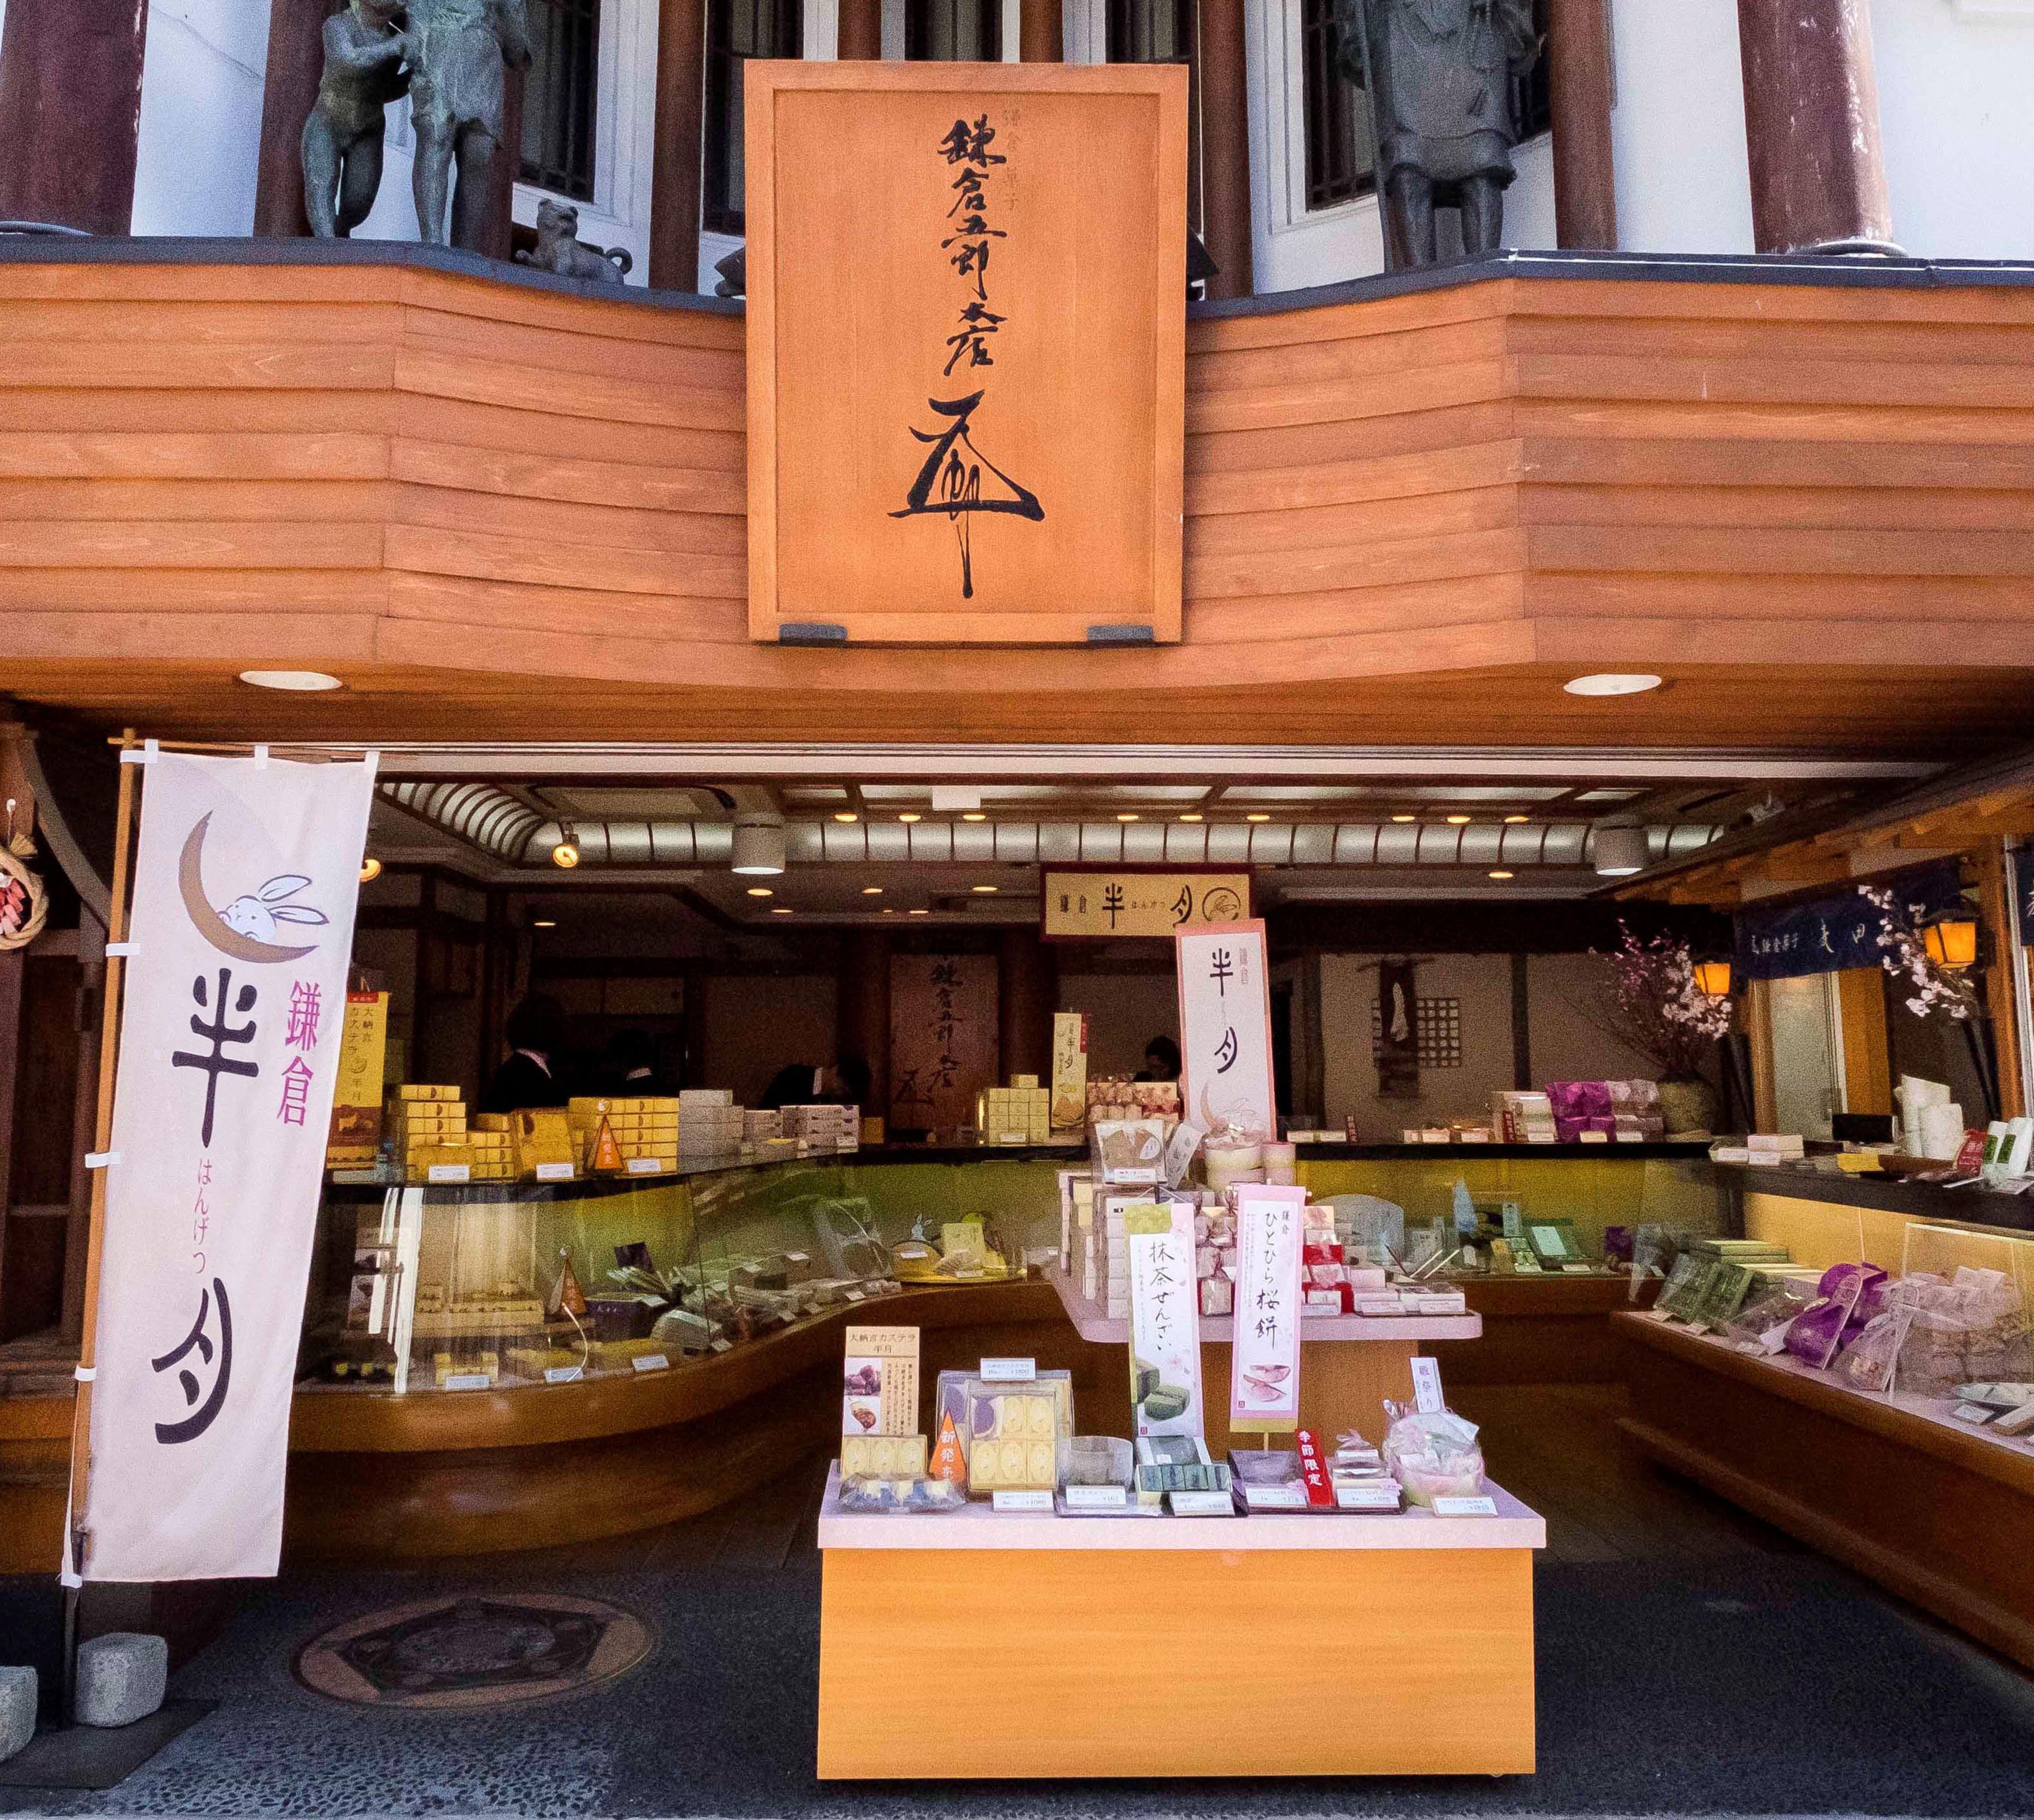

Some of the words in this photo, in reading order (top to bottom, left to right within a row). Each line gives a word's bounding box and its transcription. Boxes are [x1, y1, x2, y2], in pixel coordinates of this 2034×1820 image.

[937, 113, 1007, 376] 鎌倉五郎本店
[277, 980, 322, 1126] 鎌倉
[1210, 948, 1238, 1074] 半月
[192, 1158, 213, 1275] はんげつ
[1149, 1241, 1175, 1351] 抹茶ぜんざい
[1255, 1212, 1280, 1350] ひとひら桜餅
[1298, 1430, 1323, 1486] 季節限定
